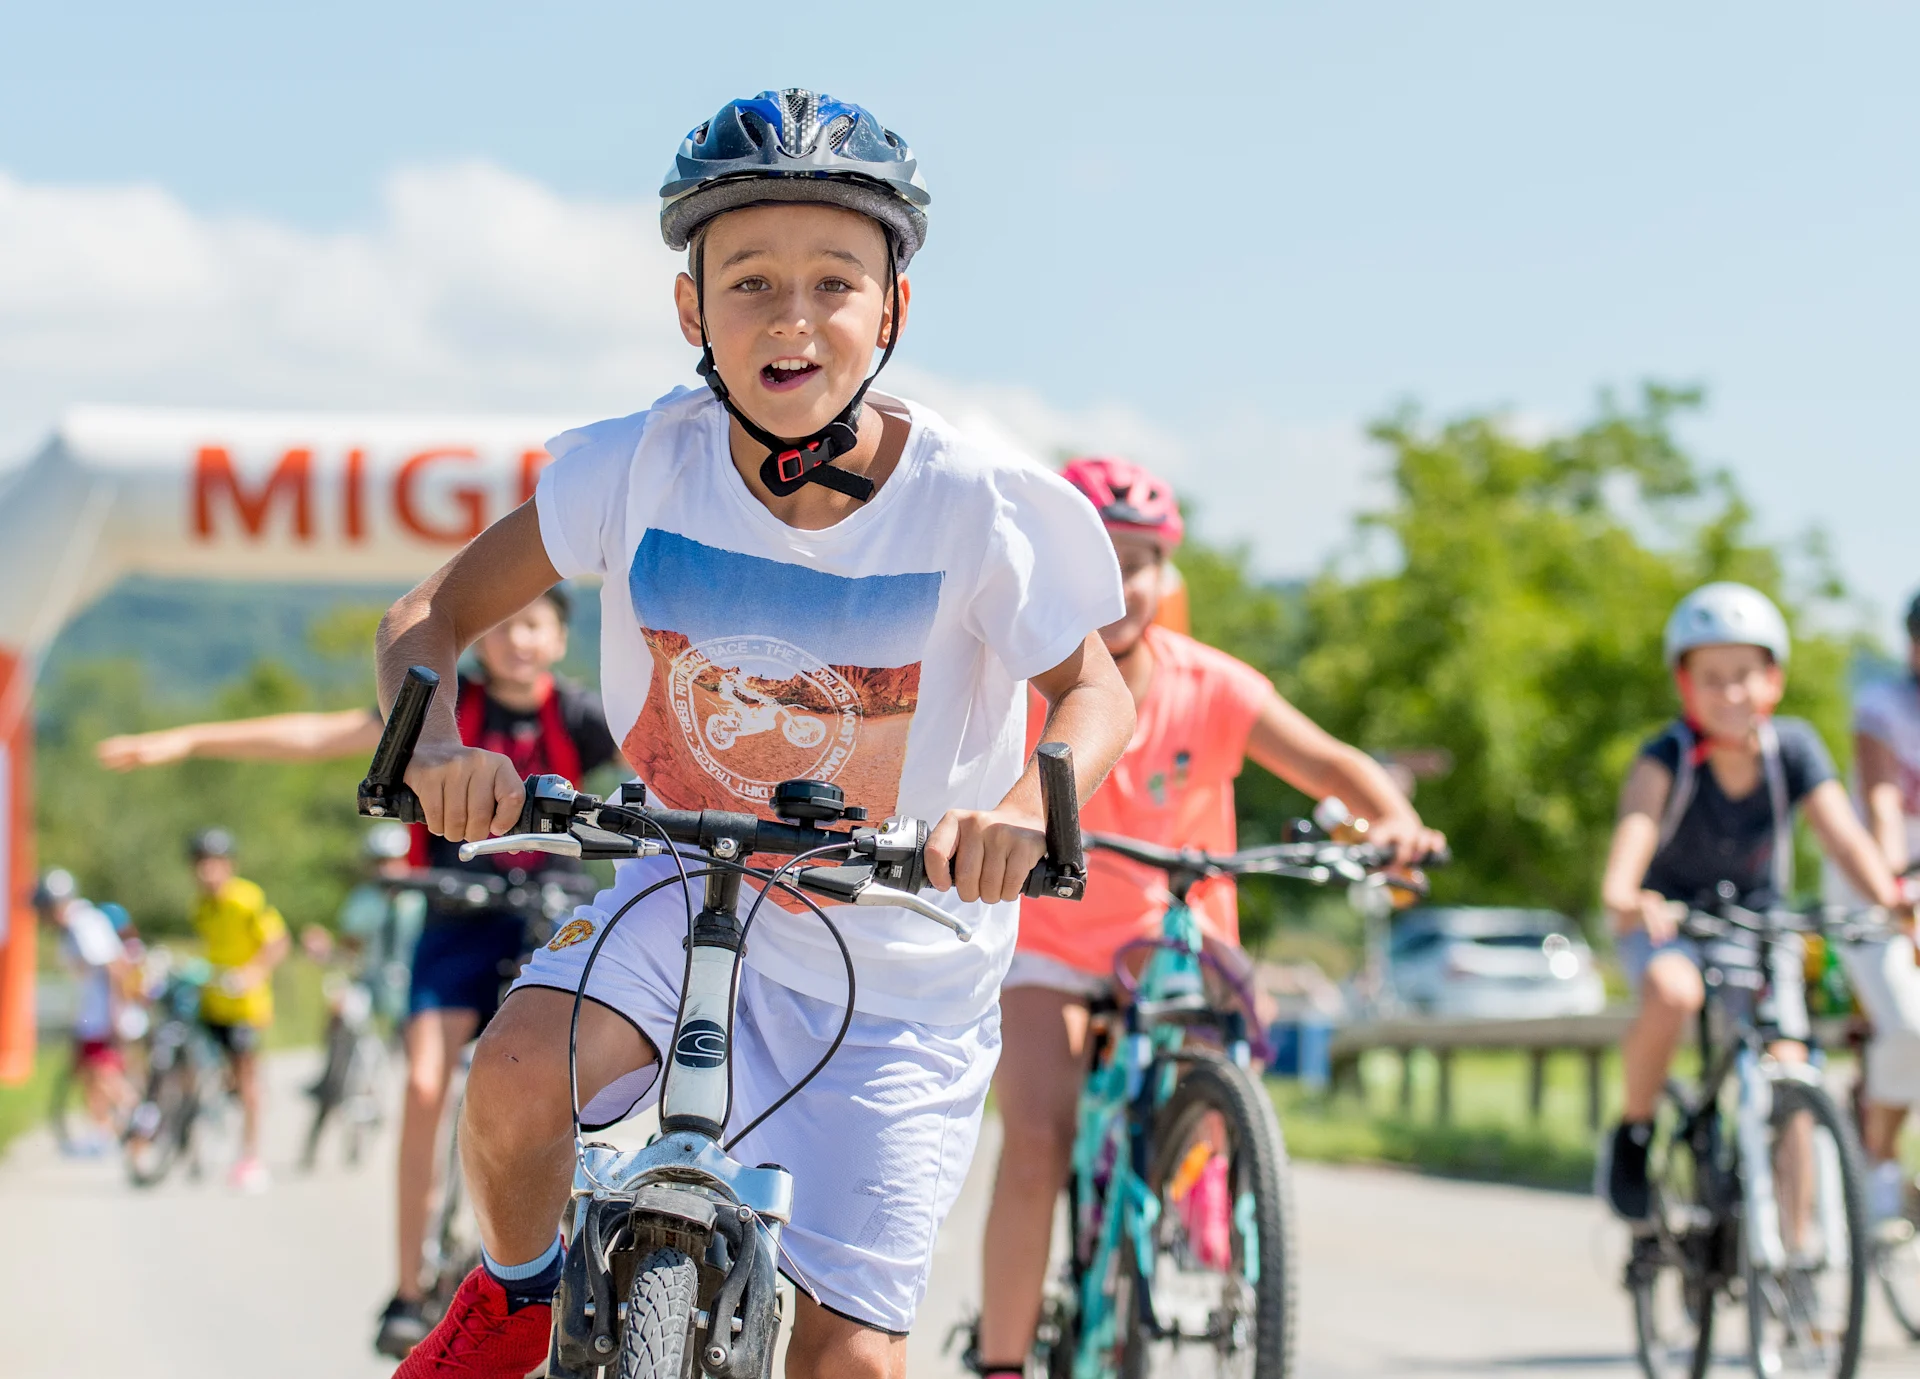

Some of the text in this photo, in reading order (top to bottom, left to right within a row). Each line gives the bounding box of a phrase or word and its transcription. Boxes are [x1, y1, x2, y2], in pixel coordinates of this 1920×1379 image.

[706, 641, 749, 658] RACE
[765, 642, 796, 663] THE
[799, 656, 851, 703] WORLDS
[838, 703, 857, 746] MOST
[694, 744, 732, 787] TRACK
[736, 781, 769, 799] DIRT
